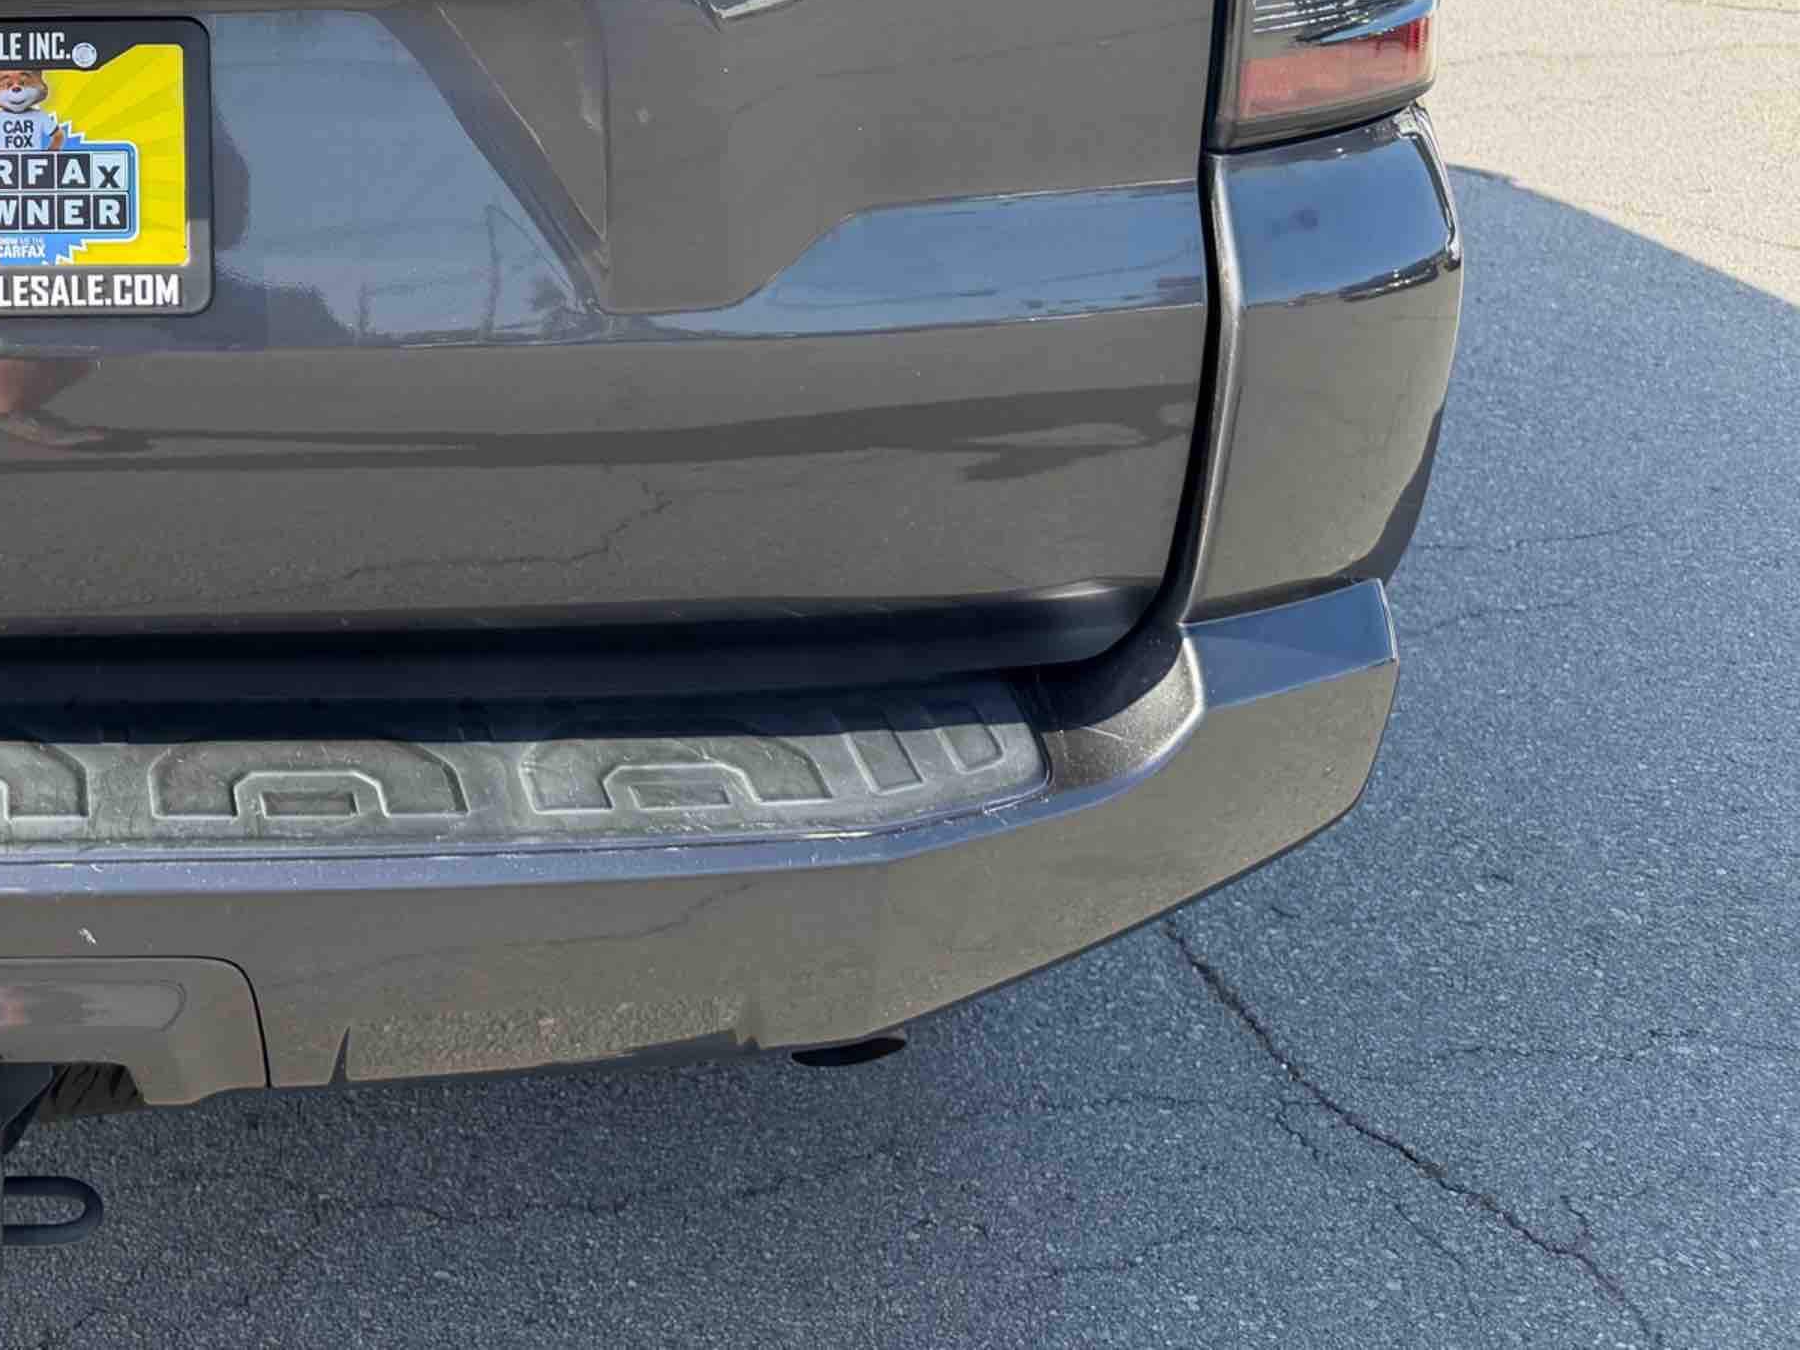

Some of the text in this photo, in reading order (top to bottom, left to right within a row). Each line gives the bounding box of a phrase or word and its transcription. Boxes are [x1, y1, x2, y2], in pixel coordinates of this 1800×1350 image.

[28, 32, 72, 62] INC.
[3, 119, 34, 135] CAR
[5, 135, 33, 148] FOX
